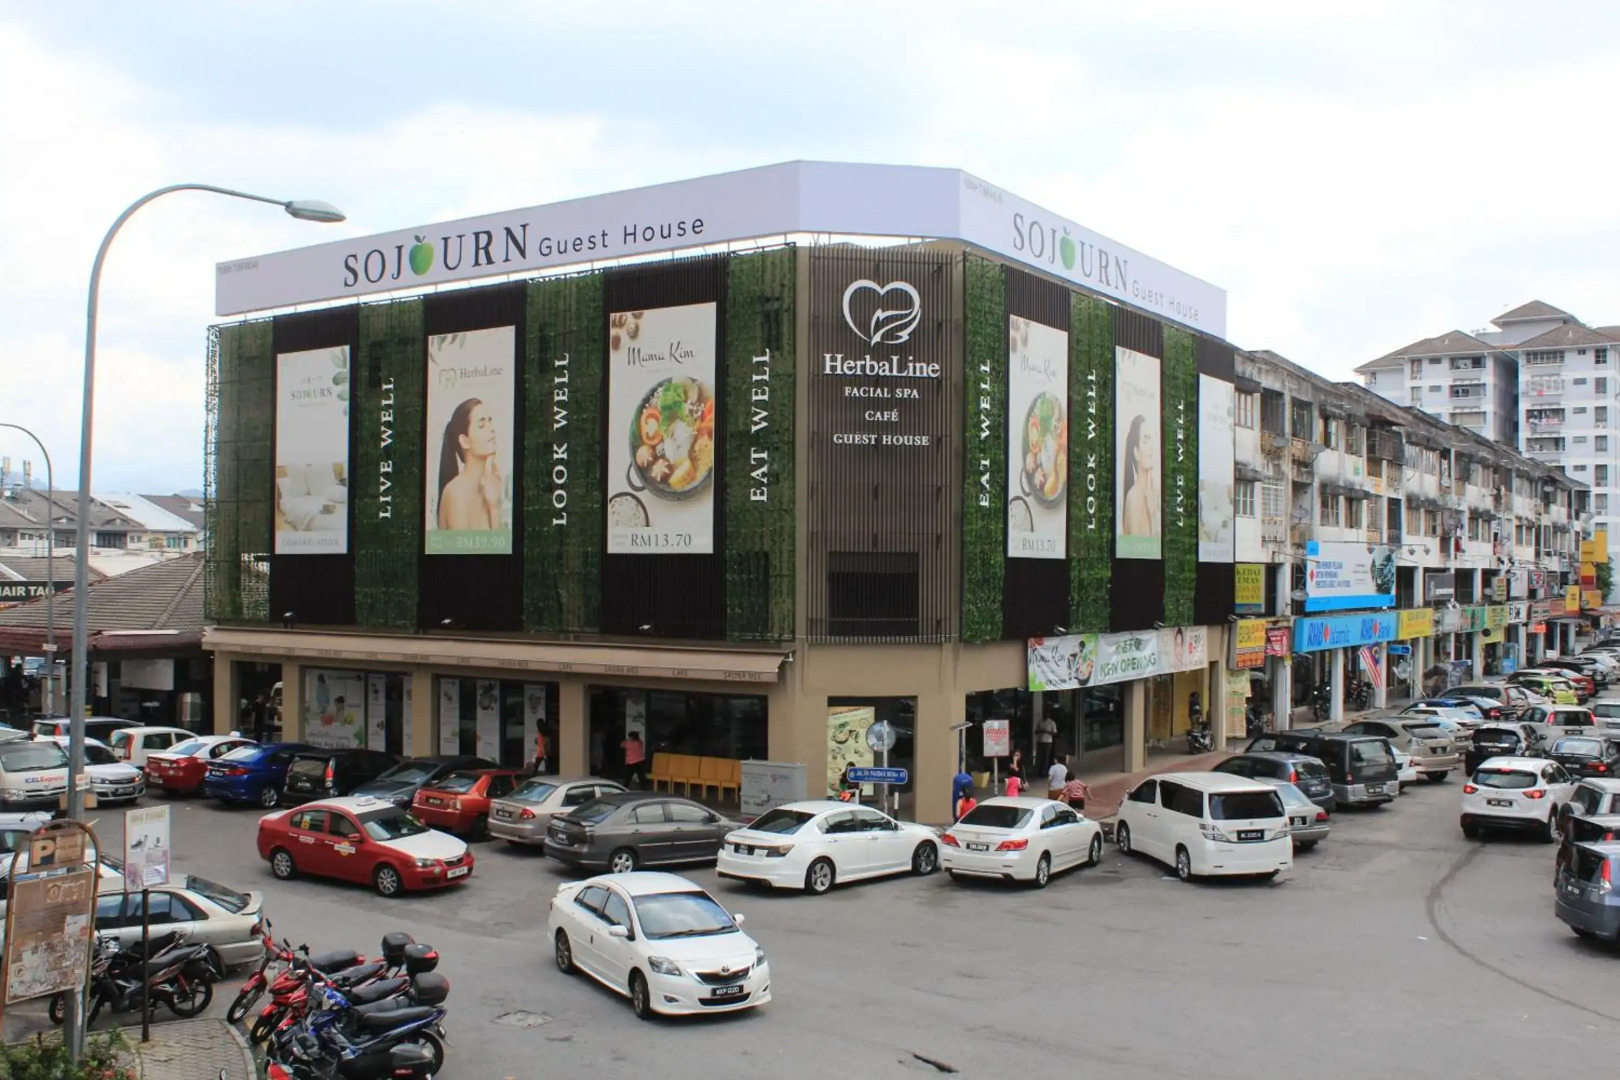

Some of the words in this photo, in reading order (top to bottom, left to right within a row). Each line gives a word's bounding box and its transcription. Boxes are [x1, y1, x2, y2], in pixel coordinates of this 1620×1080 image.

[343, 223, 530, 287] SOJOURN
[538, 229, 608, 257] Guest
[624, 217, 705, 246] House
[1013, 213, 1129, 292] SOJOURN
[1132, 279, 1164, 306] Guest
[1169, 294, 1200, 321] House
[627, 346, 665, 367] Mama
[669, 340, 695, 364] Kim
[823, 353, 940, 378] HerbaLine
[380, 377, 394, 449] WELL
[554, 353, 570, 432] WELL
[752, 348, 770, 433] WELL
[845, 386, 891, 398] FACIAL
[895, 388, 920, 399] SPA
[865, 409, 899, 421] CAFÉ
[980, 359, 991, 440] WELL
[1087, 369, 1096, 440] WELL
[833, 433, 878, 444] GUEST
[882, 435, 930, 446] HOUSE
[1177, 400, 1185, 462] WELL
[379, 460, 393, 519] LIVE
[553, 443, 568, 526] LOOK
[751, 447, 769, 502] EAT
[979, 457, 991, 509] EAT
[1086, 453, 1096, 531] LOOK
[1176, 474, 1185, 528] LIVE
[631, 533, 692, 547] RM13.70
[1307, 621, 1324, 647] RHB
[31, 839, 55, 867] P
